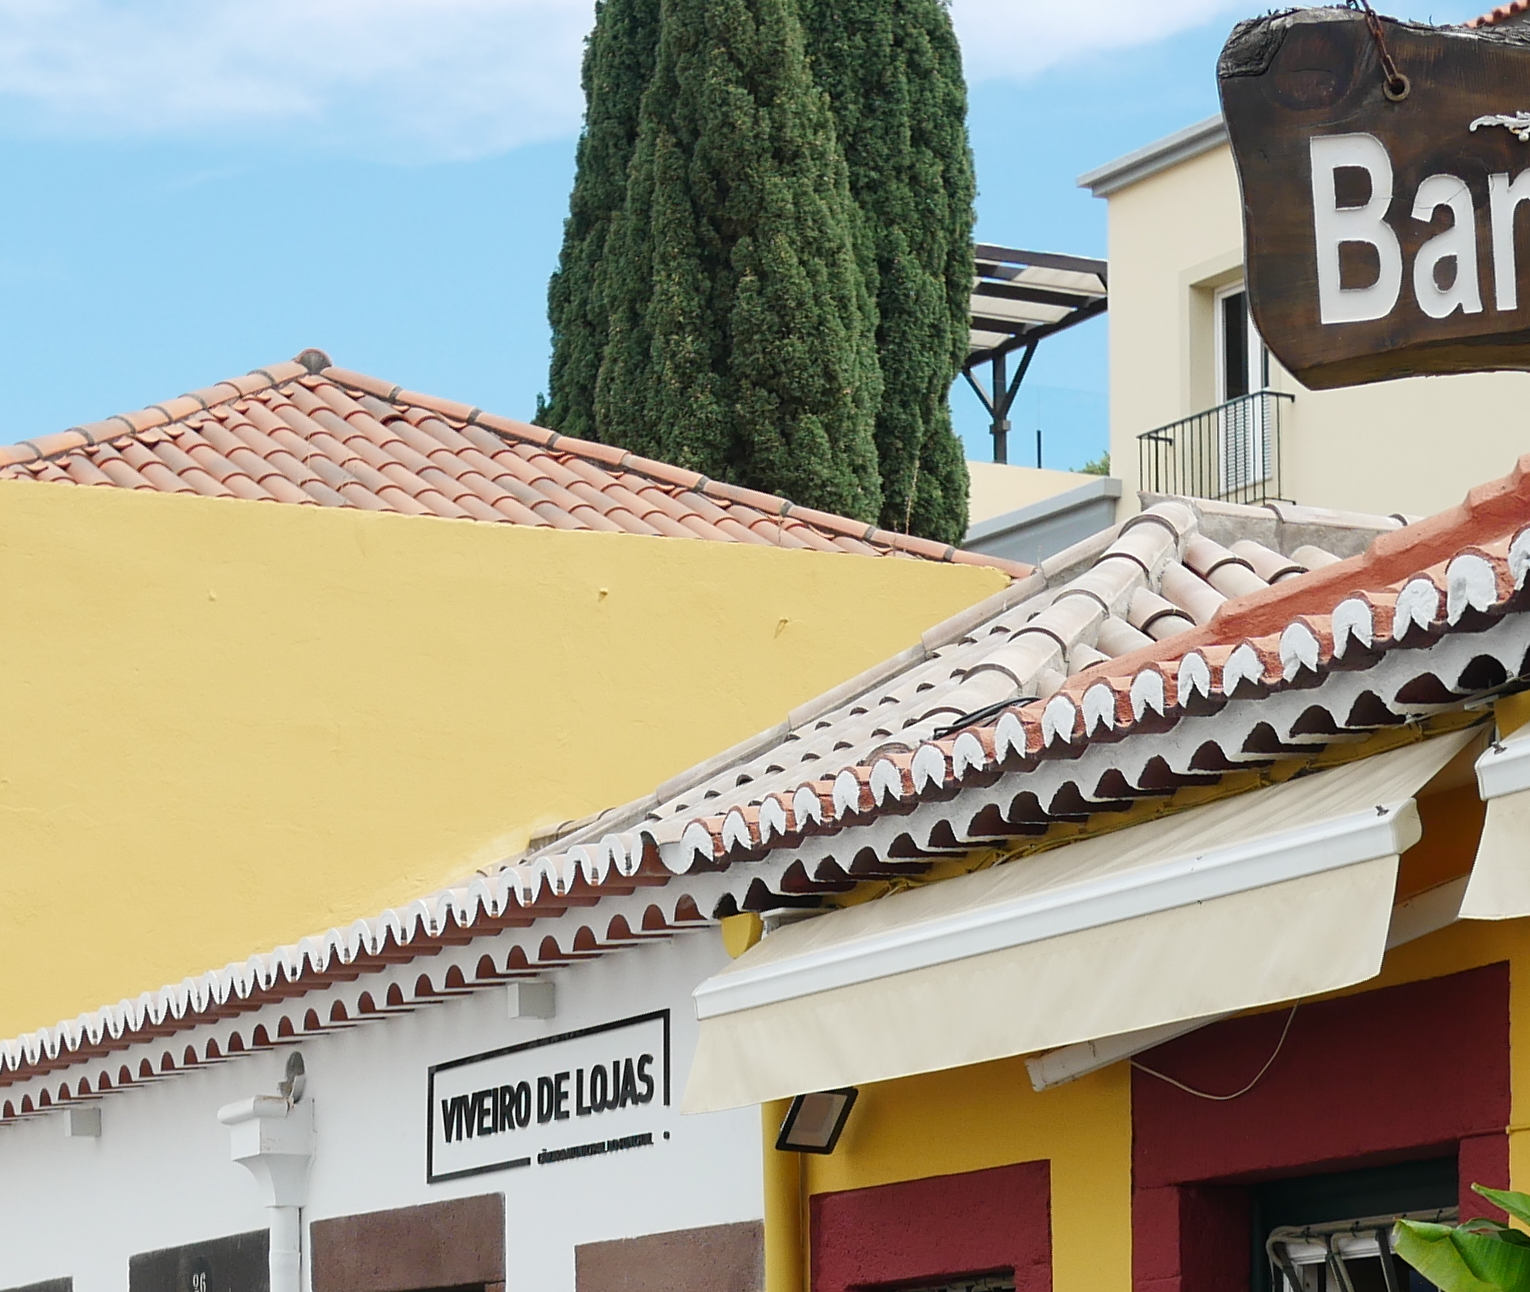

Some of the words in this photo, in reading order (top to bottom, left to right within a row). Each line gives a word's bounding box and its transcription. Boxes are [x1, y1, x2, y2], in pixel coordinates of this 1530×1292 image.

[442, 1081, 531, 1143] VIVEIRO
[537, 1071, 571, 1124] DE
[576, 1053, 654, 1116] LOJAS
